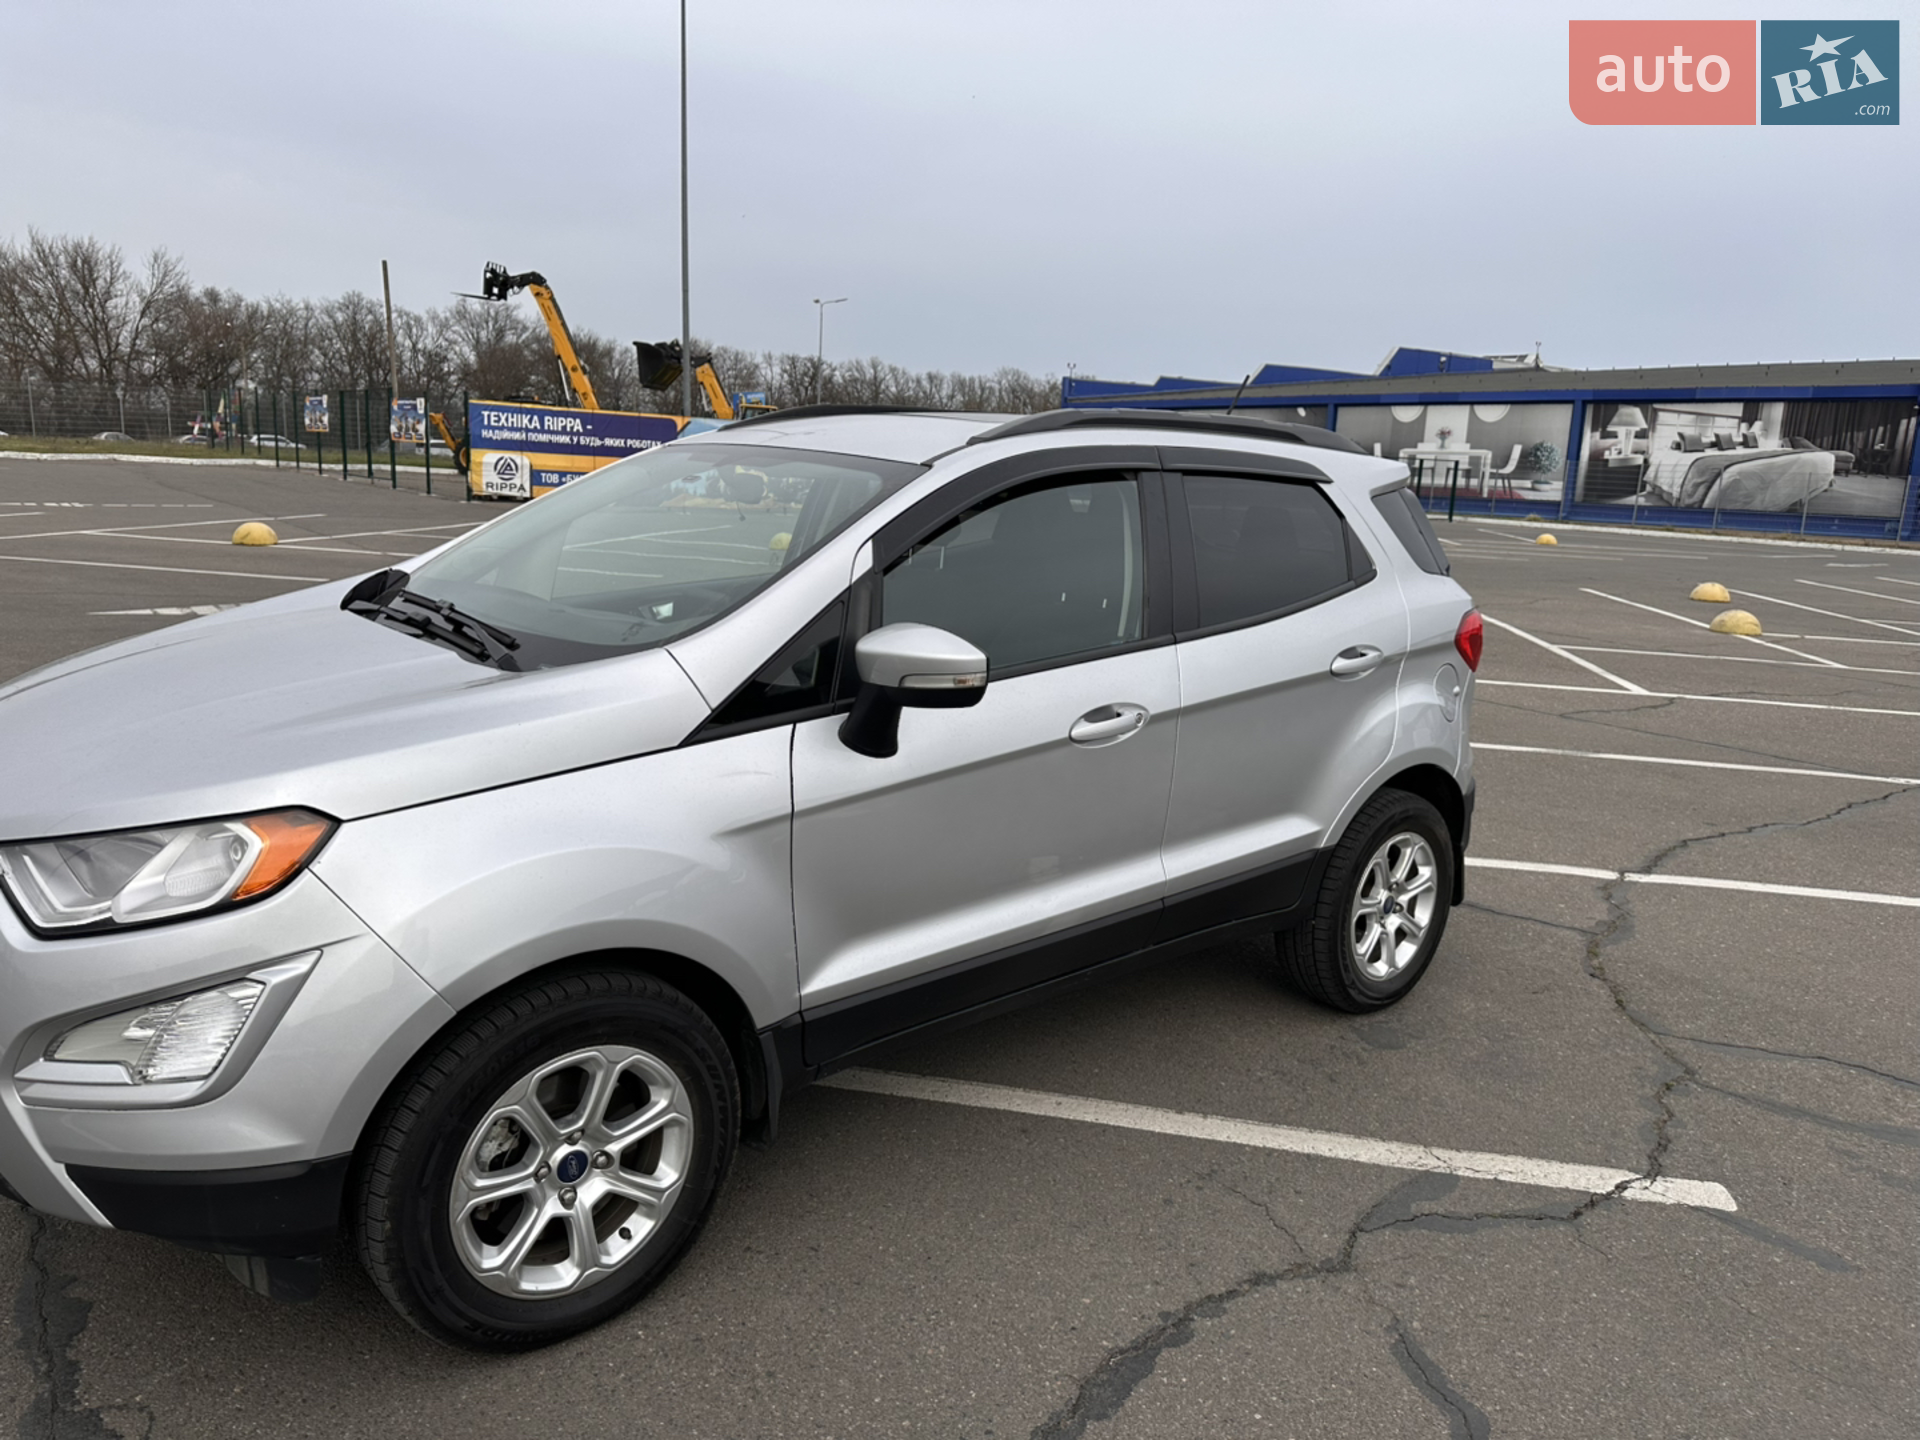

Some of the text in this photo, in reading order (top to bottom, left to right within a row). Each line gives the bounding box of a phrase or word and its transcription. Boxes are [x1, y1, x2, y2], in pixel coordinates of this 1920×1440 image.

[481, 410, 541, 429] ТЕХНІКА
[544, 415, 583, 432] RIPPA
[481, 428, 526, 441] НАДІЙНИЙ
[527, 432, 572, 444] ПОМІЧНИК
[572, 435, 578, 445] У
[580, 435, 625, 448] БУДЬ-ЯКИХ
[540, 472, 560, 484] ТОВ
[485, 481, 527, 493] RIPPA
